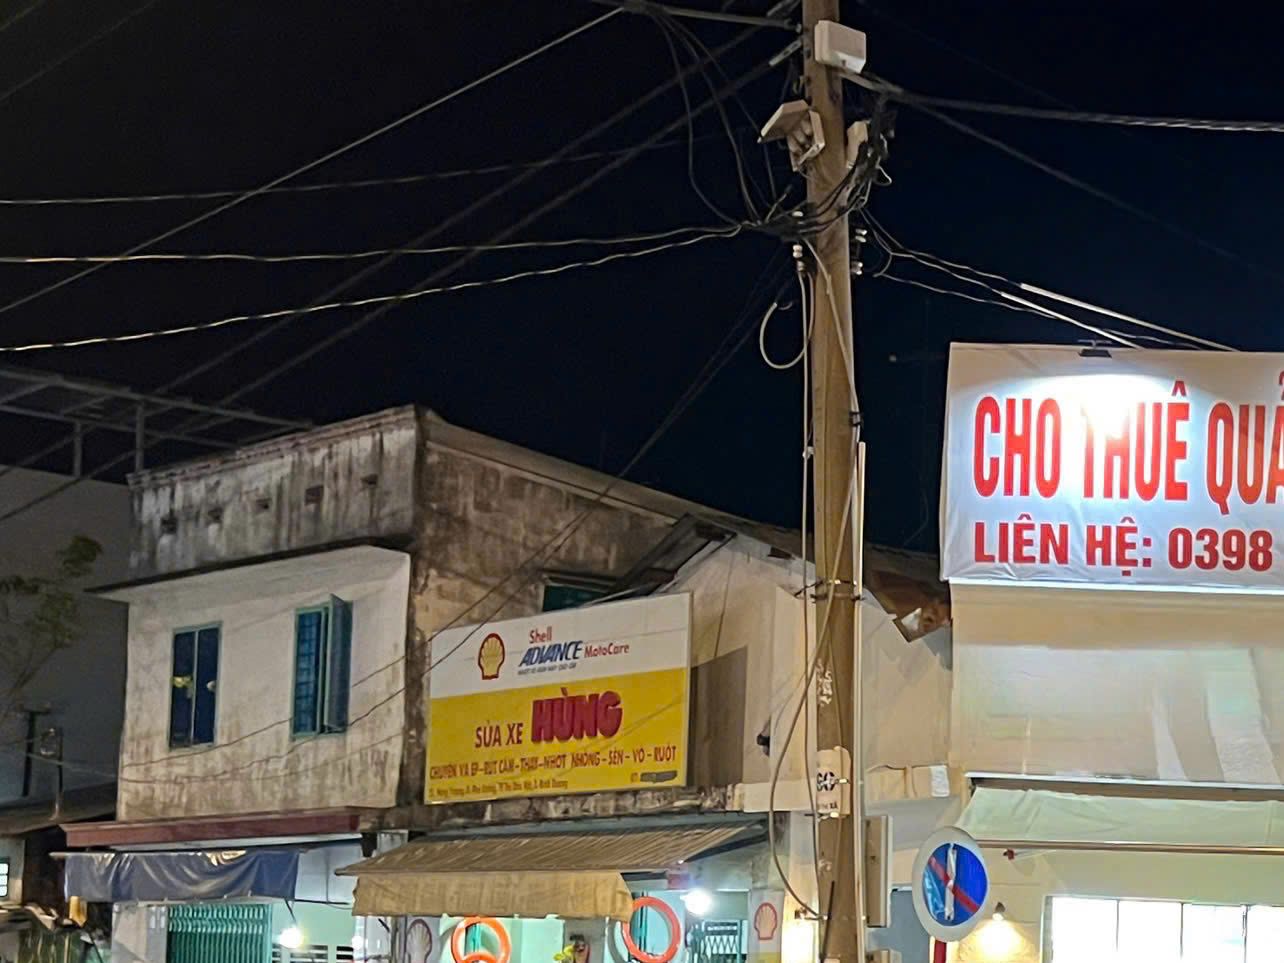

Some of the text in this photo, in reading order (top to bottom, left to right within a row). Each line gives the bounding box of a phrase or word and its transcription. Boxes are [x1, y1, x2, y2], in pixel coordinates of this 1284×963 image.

[972, 395, 1062, 499] CHO
[1082, 380, 1188, 501] THUÊ
[974, 513, 1069, 566] LIÊN
[1086, 516, 1152, 577] HỆ:
[1168, 527, 1273, 573] 0398
[518, 641, 630, 667] ADVANCE MotoCare
[529, 626, 552, 644] Shell
[506, 723, 523, 745] XE
[531, 687, 623, 744] HÙNG
